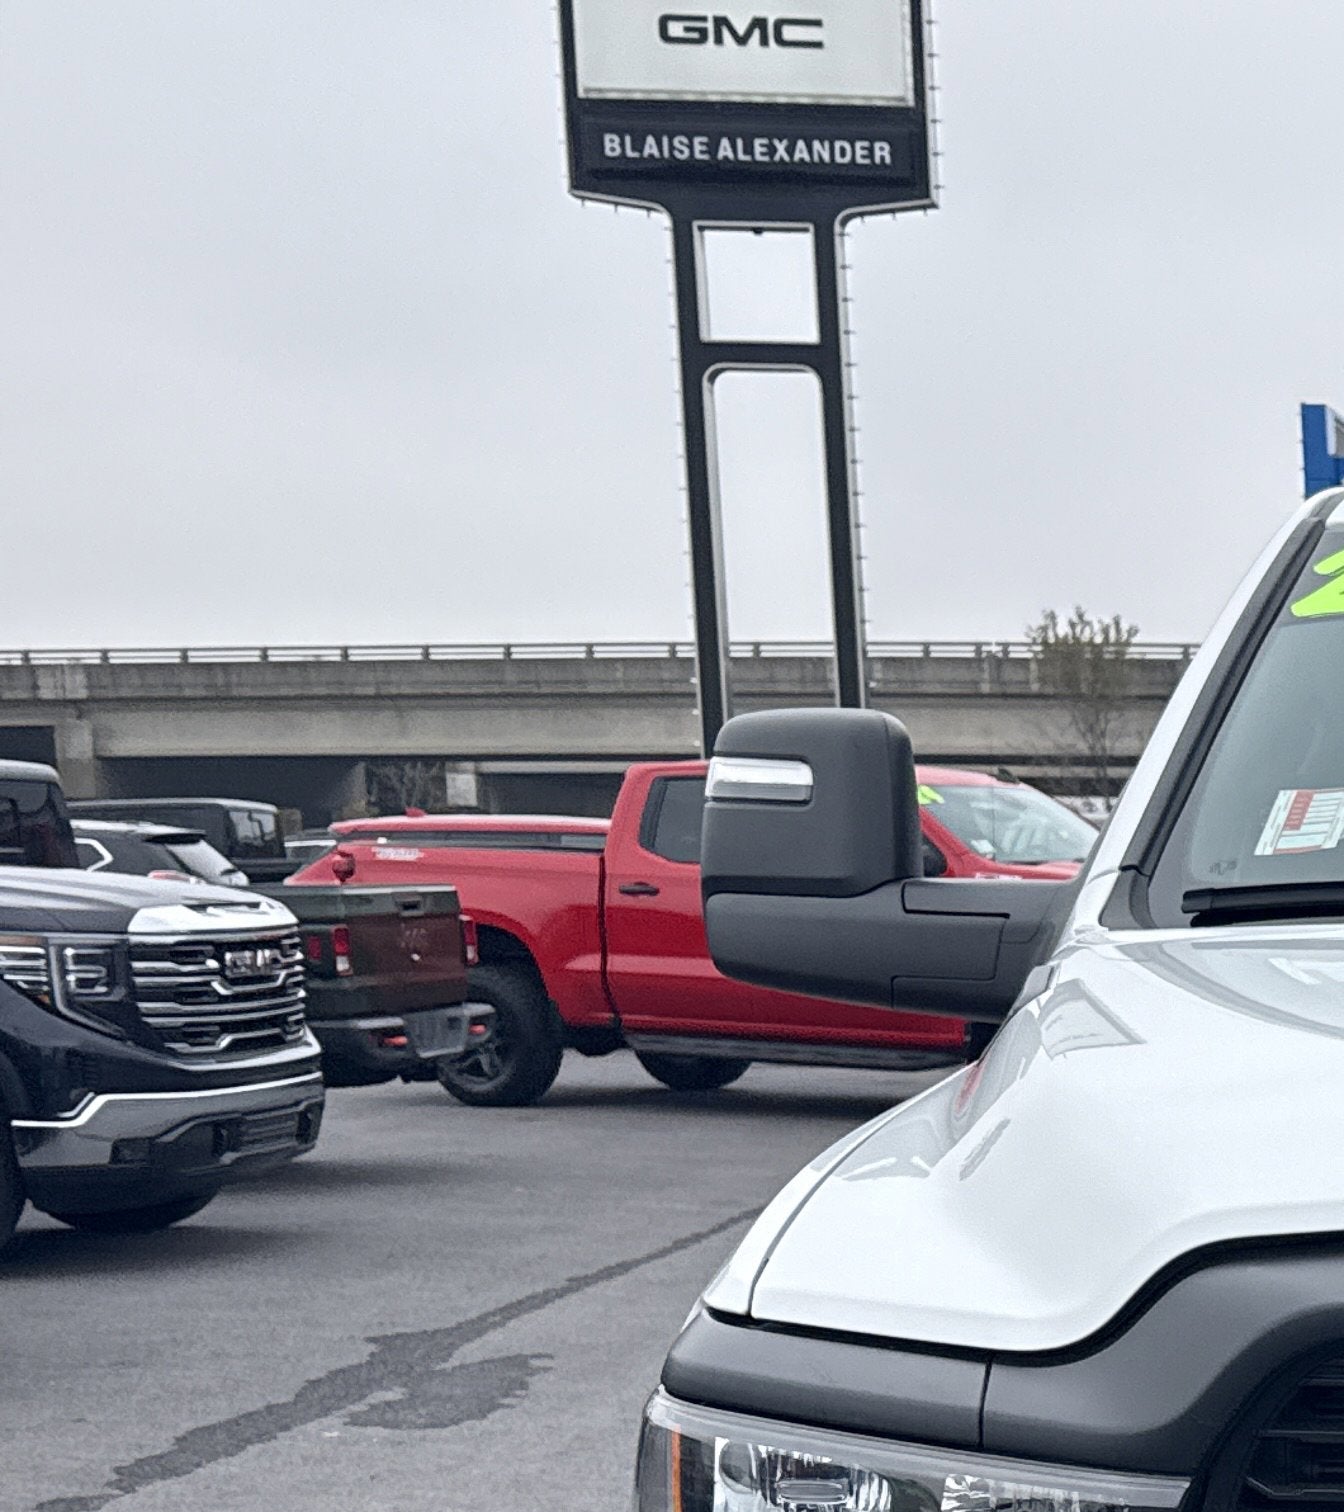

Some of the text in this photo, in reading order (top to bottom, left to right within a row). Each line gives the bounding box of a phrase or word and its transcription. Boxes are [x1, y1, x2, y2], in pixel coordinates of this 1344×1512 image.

[658, 14, 824, 49] GMC
[602, 132, 892, 165] BLAISE ALEXANDER
